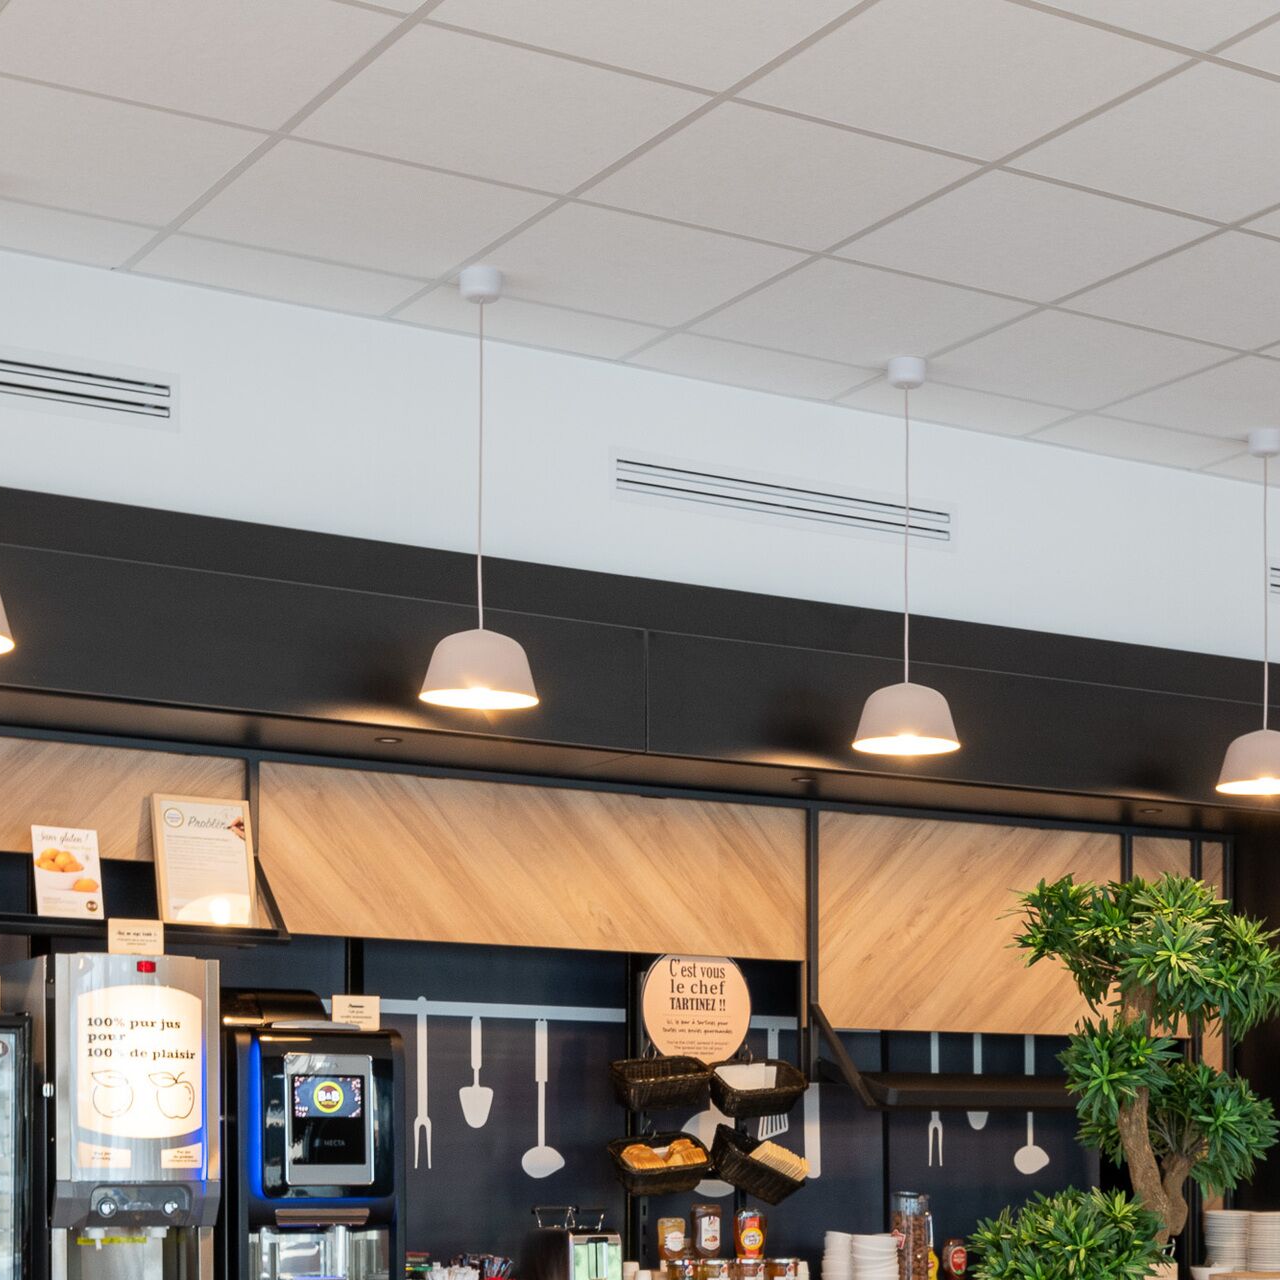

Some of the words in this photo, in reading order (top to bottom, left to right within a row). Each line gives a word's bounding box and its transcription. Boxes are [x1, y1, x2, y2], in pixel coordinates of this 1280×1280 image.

[700, 965, 726, 979] vous
[670, 978, 685, 994] le
[690, 979, 726, 995] chef
[669, 996, 716, 1011] TARTINEZ
[130, 1019, 157, 1030] pur
[160, 1018, 181, 1031] jus
[130, 1048, 148, 1058] de
[152, 1049, 196, 1061] plaisir
